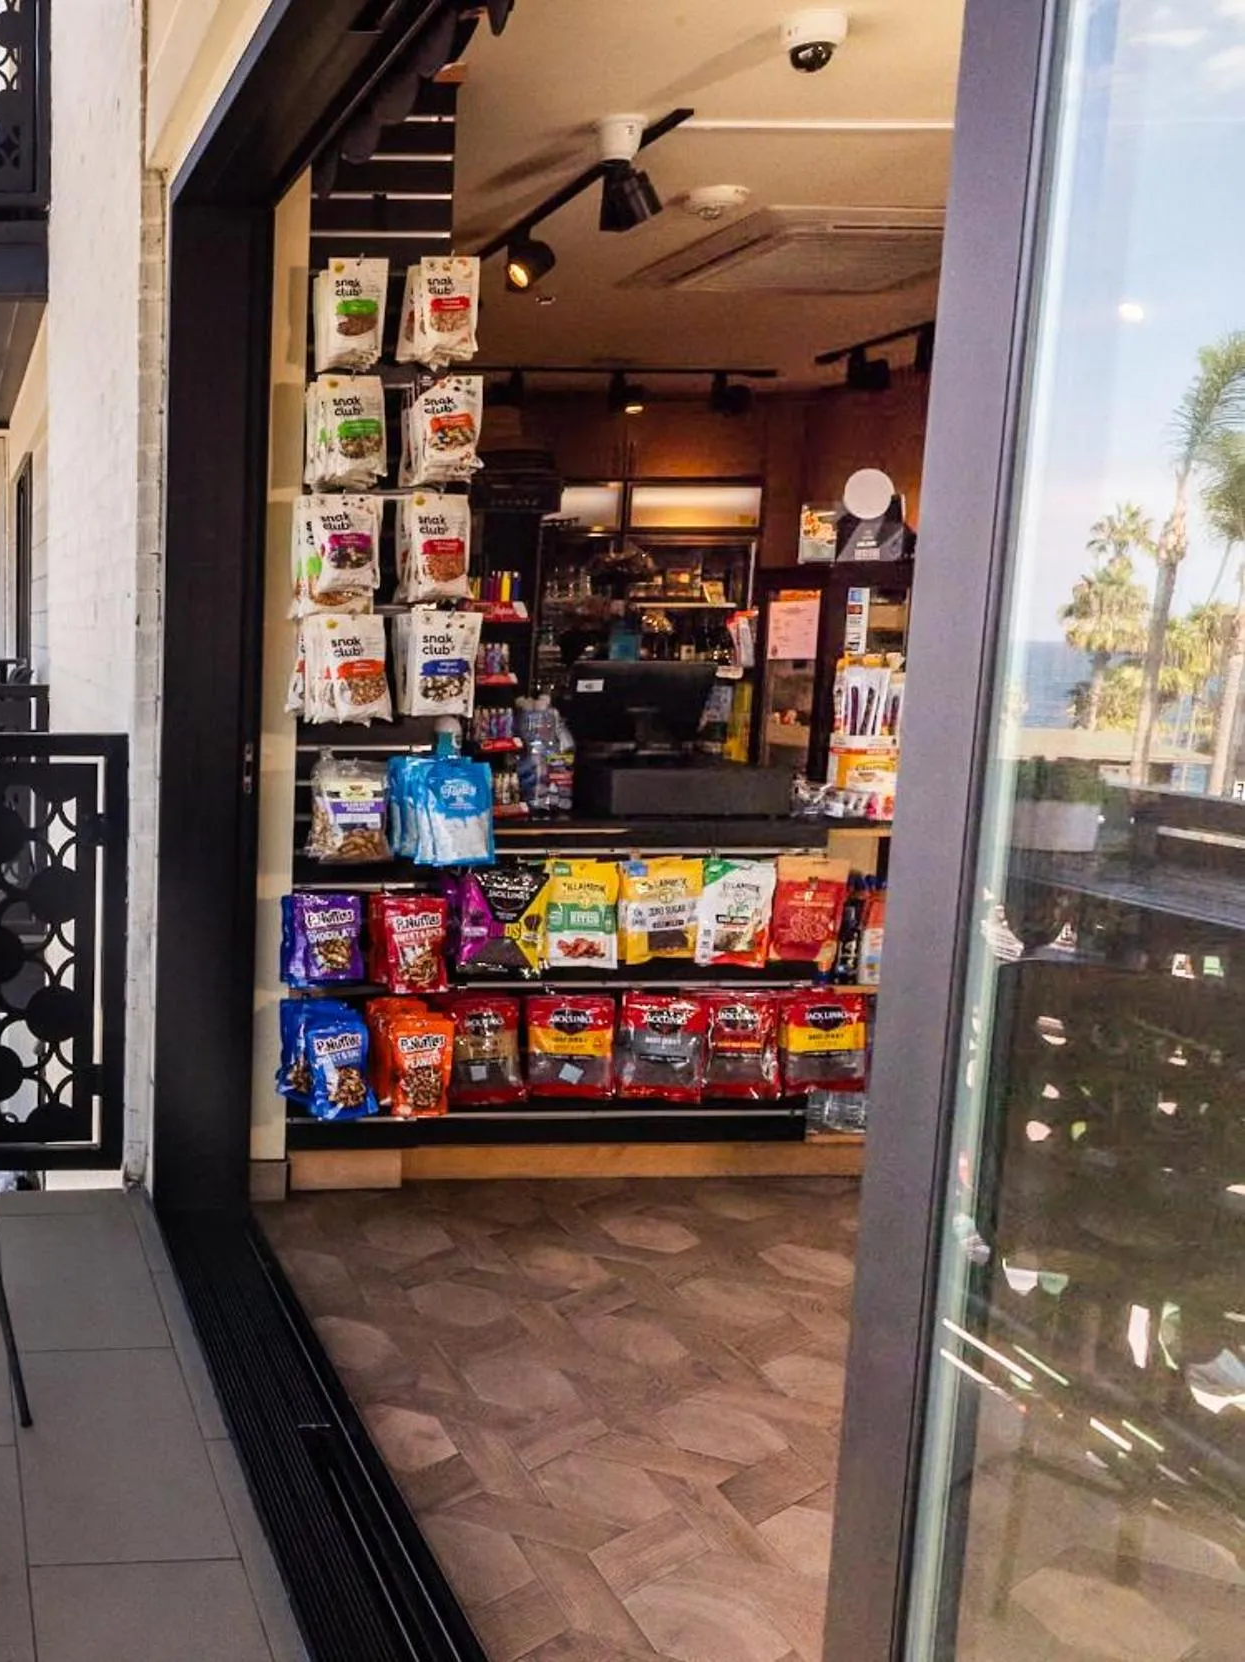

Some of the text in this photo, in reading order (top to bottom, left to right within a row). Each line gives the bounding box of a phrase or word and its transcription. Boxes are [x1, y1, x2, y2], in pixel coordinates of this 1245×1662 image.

[335, 278, 361, 288] snak
[335, 288, 358, 297] club
[333, 396, 361, 406] snak
[424, 396, 454, 406] snak
[424, 405, 453, 414] club
[320, 511, 349, 522] snak
[419, 525, 446, 535] club
[331, 635, 361, 648] snak
[422, 633, 453, 643] snak
[334, 647, 361, 657] club
[422, 644, 451, 655] club
